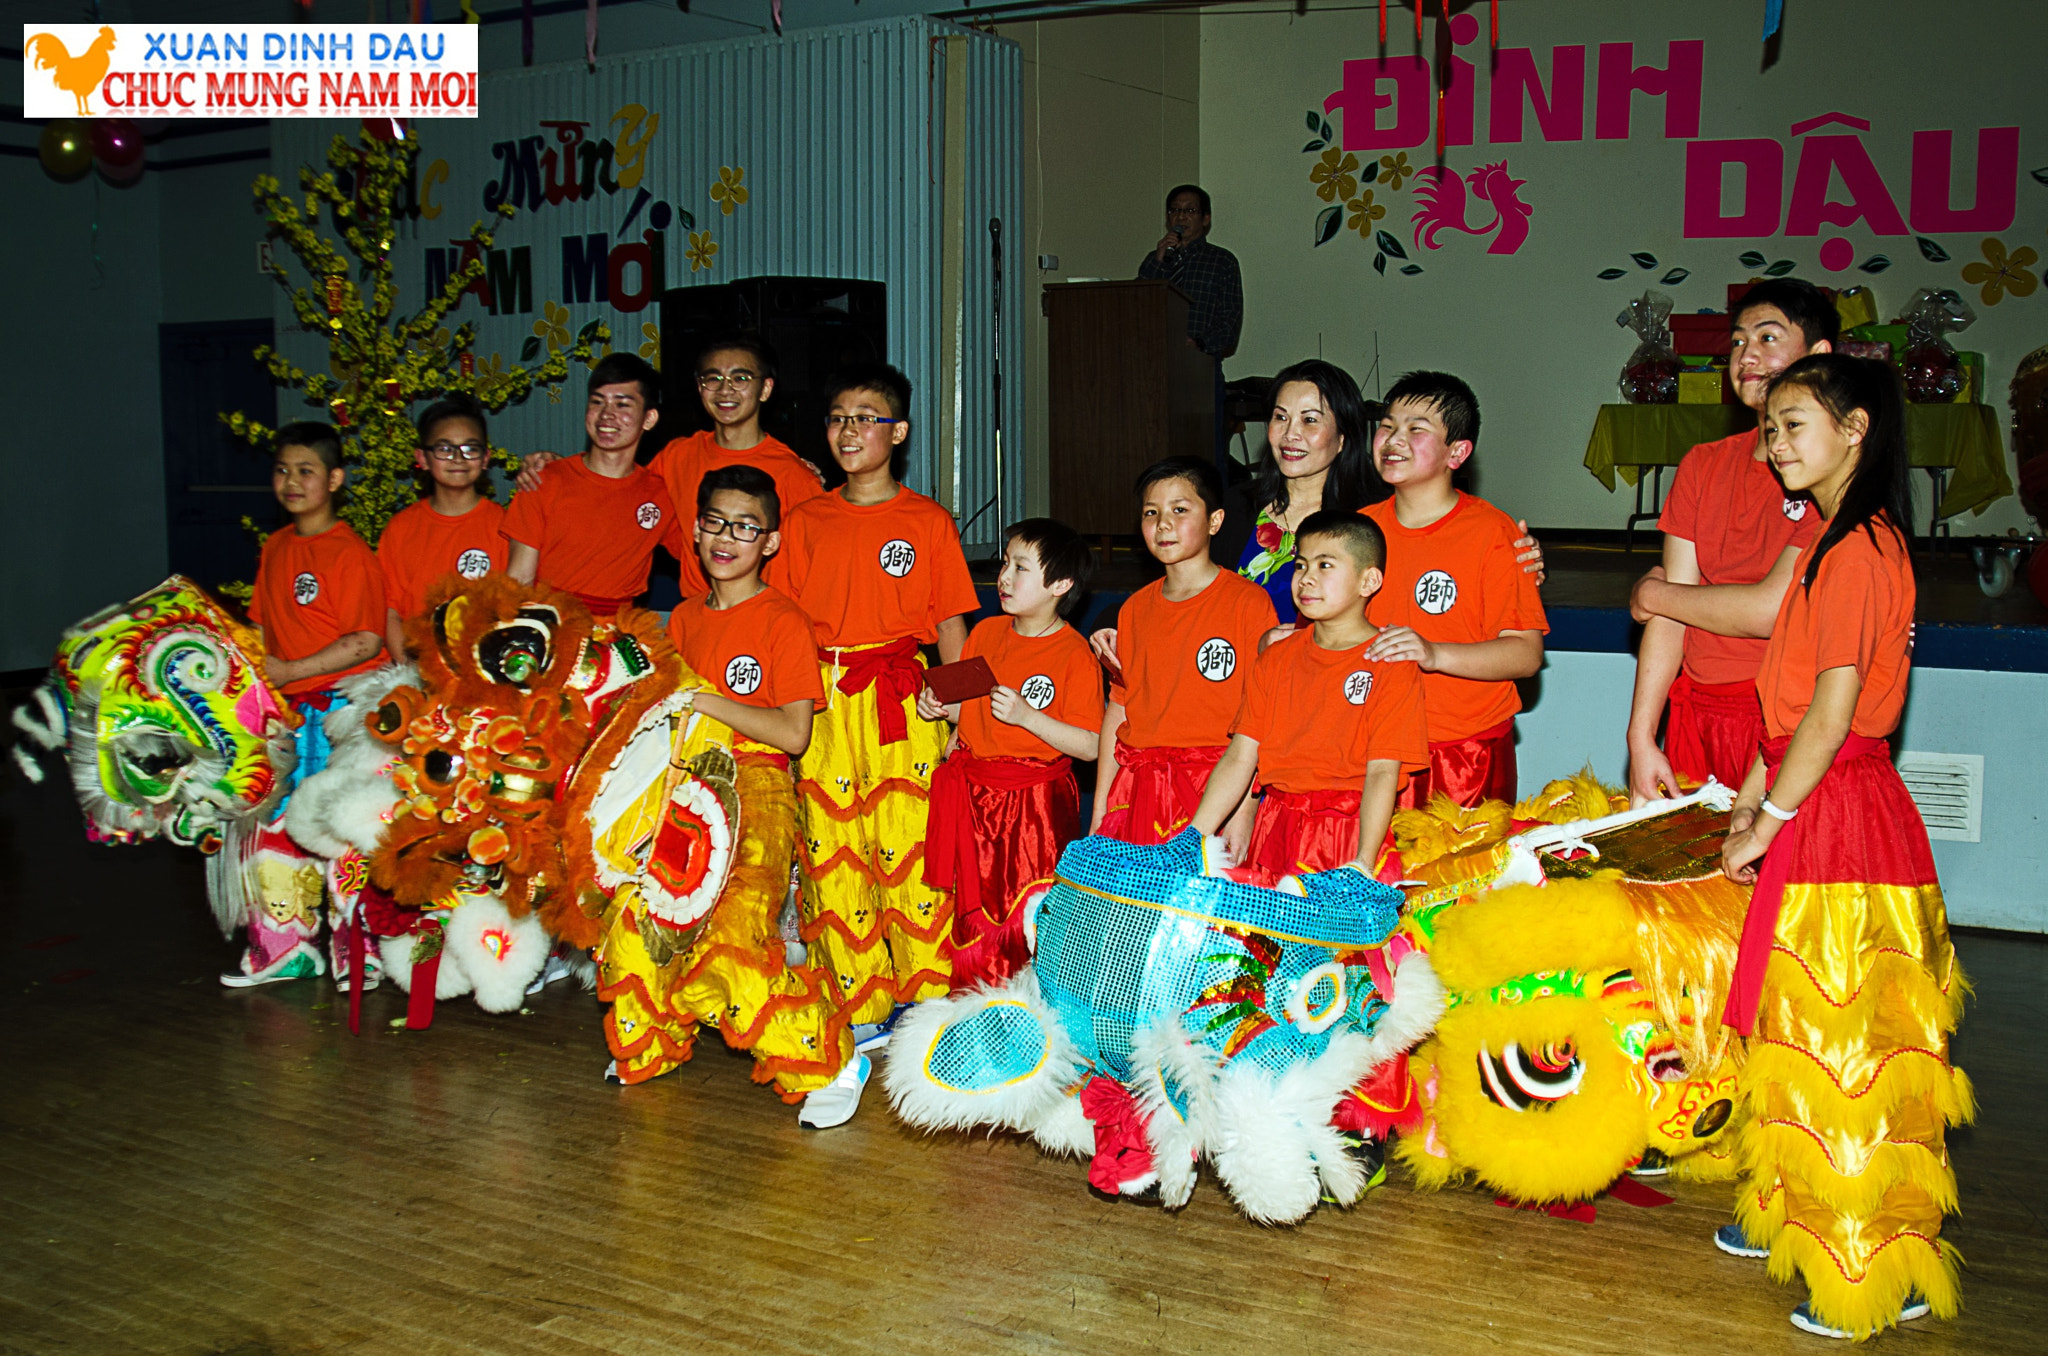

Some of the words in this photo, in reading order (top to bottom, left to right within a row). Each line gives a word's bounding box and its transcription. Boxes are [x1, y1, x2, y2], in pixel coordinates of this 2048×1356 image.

[639, 505, 659, 527] 獅
[459, 552, 489, 577] 獅
[882, 543, 914, 576] 獅
[1418, 575, 1456, 613] 獅
[729, 659, 758, 692] 獅
[1200, 643, 1234, 680] 獅
[1022, 678, 1054, 709] 獅
